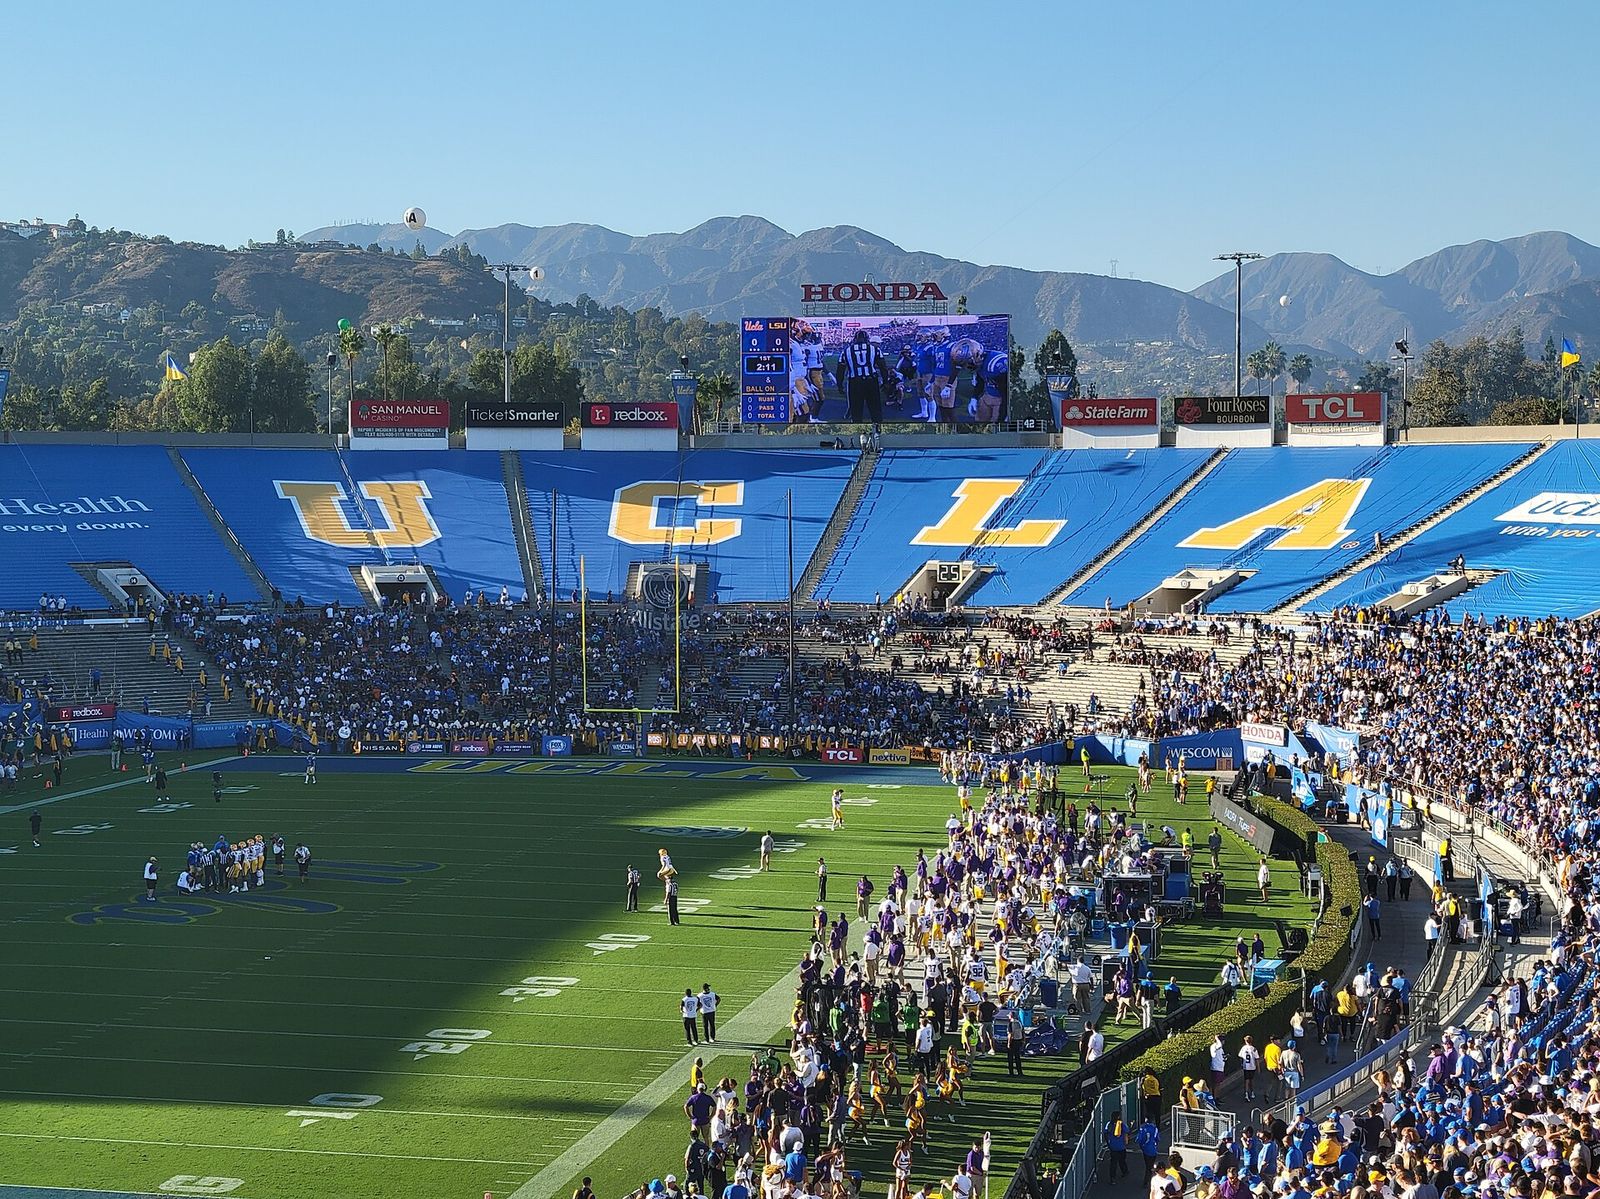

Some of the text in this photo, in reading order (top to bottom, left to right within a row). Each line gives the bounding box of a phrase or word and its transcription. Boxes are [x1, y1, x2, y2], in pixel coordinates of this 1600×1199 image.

[801, 283, 948, 302] HONDA
[745, 320, 764, 331] Ucla
[751, 338, 758, 346] 0
[775, 338, 781, 346] 0
[756, 363, 776, 371] 2:11
[371, 405, 442, 414] SAN MANUEL
[614, 407, 668, 421] redbox.
[1302, 397, 1364, 419] TCL
[470, 409, 560, 421] TicketSmarter
[1216, 414, 1255, 423] BOURBON
[1023, 419, 1035, 428] 42
[0, 496, 154, 516] Health
[2, 521, 150, 533] every down.
[1498, 525, 1549, 537] With
[1546, 529, 1595, 539] you
[940, 565, 959, 581] 25
[79, 729, 109, 739] Health
[1242, 725, 1283, 741] HONDA
[826, 750, 858, 760] TCL
[872, 751, 907, 762] nextiva
[1169, 747, 1220, 758] WESCOM
[406, 760, 812, 781] UCLA
[584, 934, 652, 951] 40
[973, 967, 983, 977] 92
[498, 976, 581, 998] 30
[400, 1028, 493, 1055] 20
[284, 1092, 384, 1120] 10
